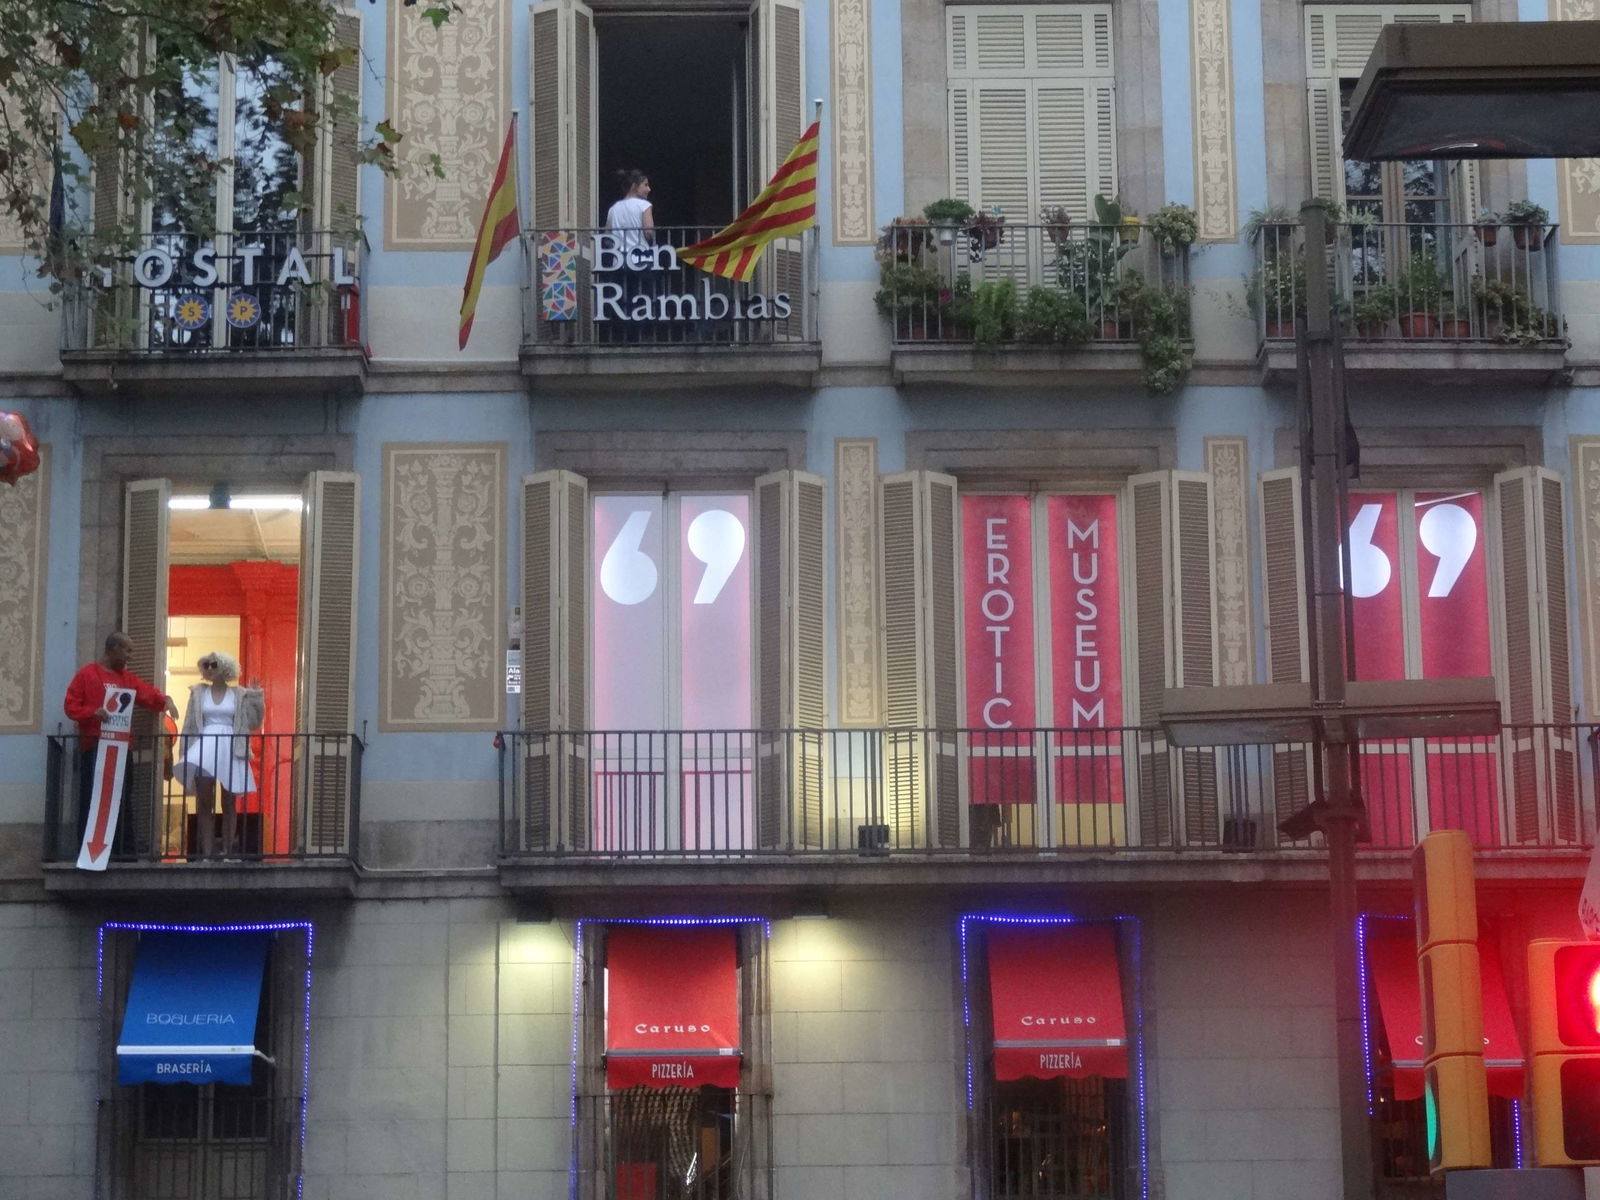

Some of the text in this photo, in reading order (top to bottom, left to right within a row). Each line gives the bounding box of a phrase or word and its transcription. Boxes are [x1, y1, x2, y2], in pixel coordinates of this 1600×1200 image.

[591, 278, 792, 321] Ramblas
[600, 509, 746, 606] 69
[981, 518, 1015, 729] EROTIC
[1067, 518, 1104, 728] MUSEUM
[146, 1013, 235, 1025] BOQUERIA
[1021, 1016, 1096, 1026] Caruso
[635, 1023, 710, 1034] Caruso
[156, 1060, 212, 1074] BRASERÍA
[1040, 1052, 1082, 1069] PIZZERÍA
[652, 1061, 694, 1078] PIZZERÍA
